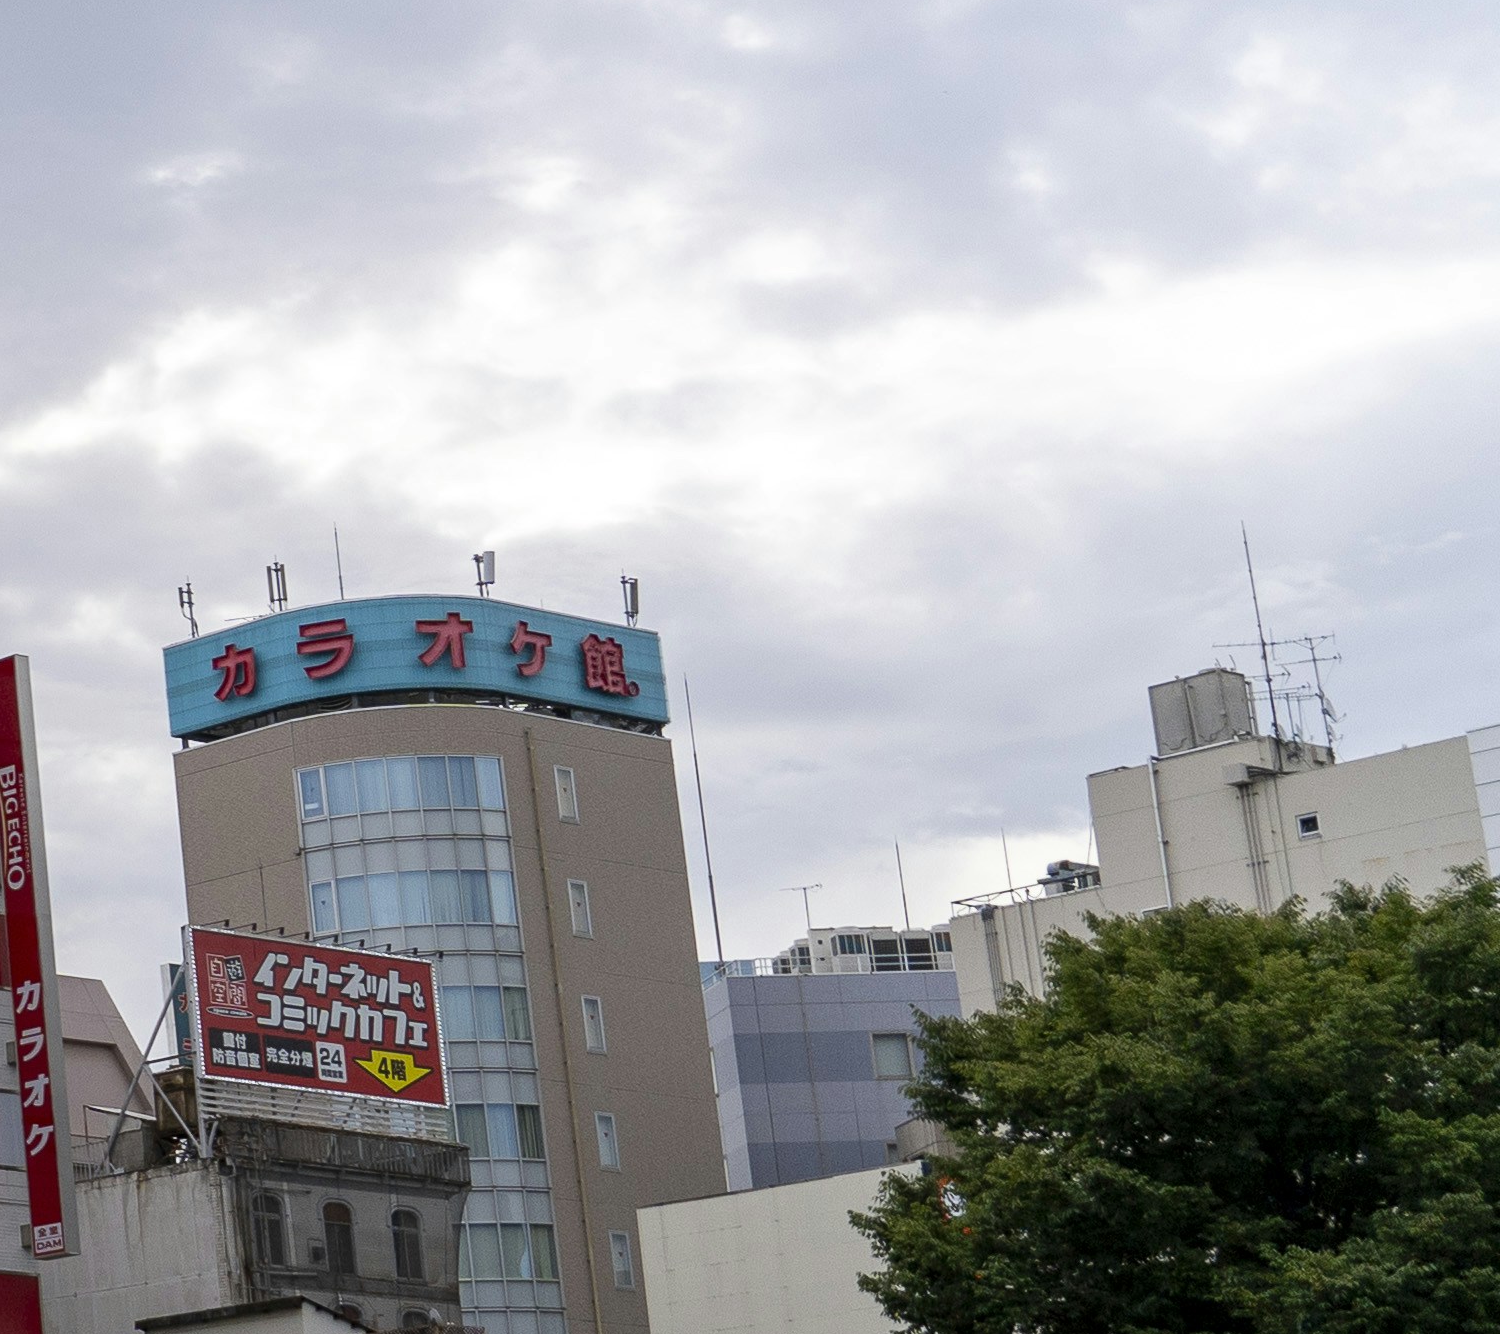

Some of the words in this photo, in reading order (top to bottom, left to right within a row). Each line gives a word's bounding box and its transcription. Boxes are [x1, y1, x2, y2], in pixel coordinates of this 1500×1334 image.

[212, 612, 640, 704] カラオケ館
[7, 818, 25, 890] ECHO
[254, 951, 426, 1010] インターネット&
[256, 992, 428, 1048] コミックカフェ
[15, 980, 54, 1157] カラオケ
[212, 1047, 261, 1070] 防音個室
[319, 1047, 343, 1067] 24
[377, 1056, 407, 1082] 4階
[36, 1239, 63, 1252] DAM
[37, 1223, 61, 1238] 全室
